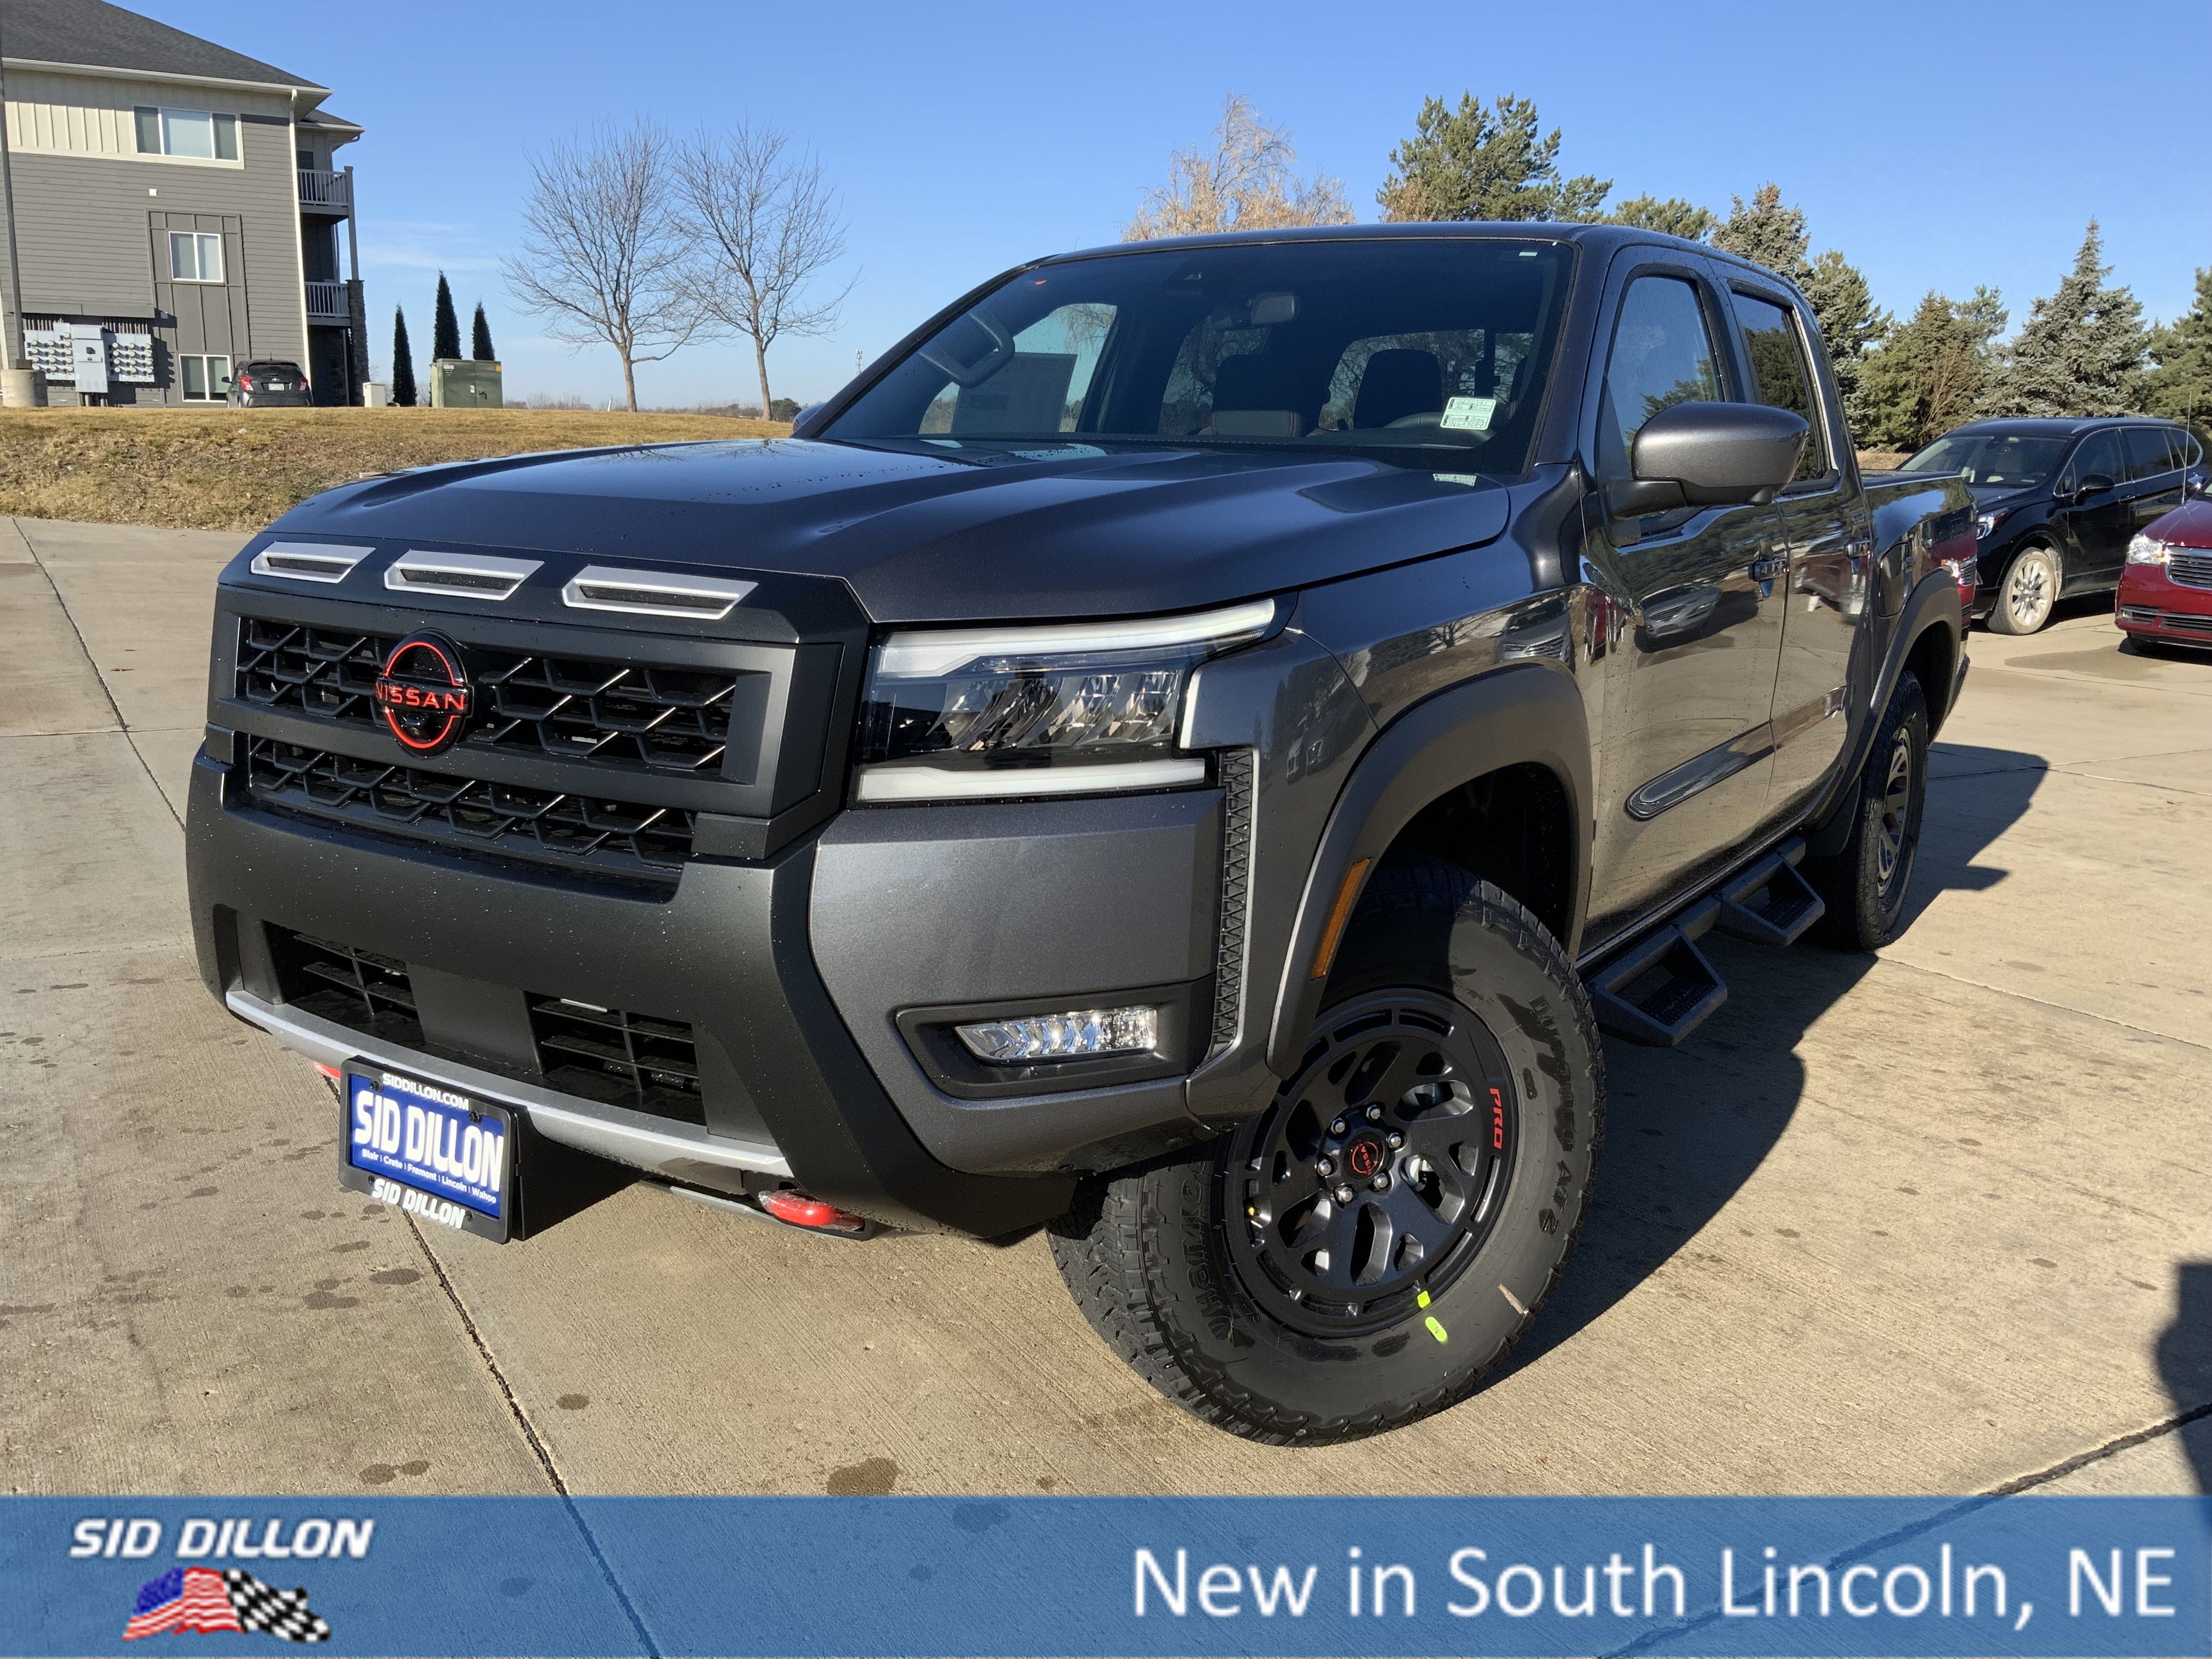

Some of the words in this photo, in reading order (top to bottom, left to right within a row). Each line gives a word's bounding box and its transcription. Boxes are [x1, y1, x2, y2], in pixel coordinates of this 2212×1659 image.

[376, 681, 465, 711] NISSAN
[382, 1073, 470, 1111] SIDDILLON.COM
[355, 1090, 401, 1154] SID
[405, 1105, 504, 1192] DILLON
[1489, 1088, 1504, 1150] PRO
[362, 1148, 379, 1162] Blair
[383, 1156, 403, 1170] Crete
[408, 1164, 438, 1182] Fremont
[442, 1176, 467, 1193] Lincoln
[471, 1186, 497, 1204] Wahoo
[371, 1178, 402, 1205] SID
[402, 1188, 466, 1229] DILLON
